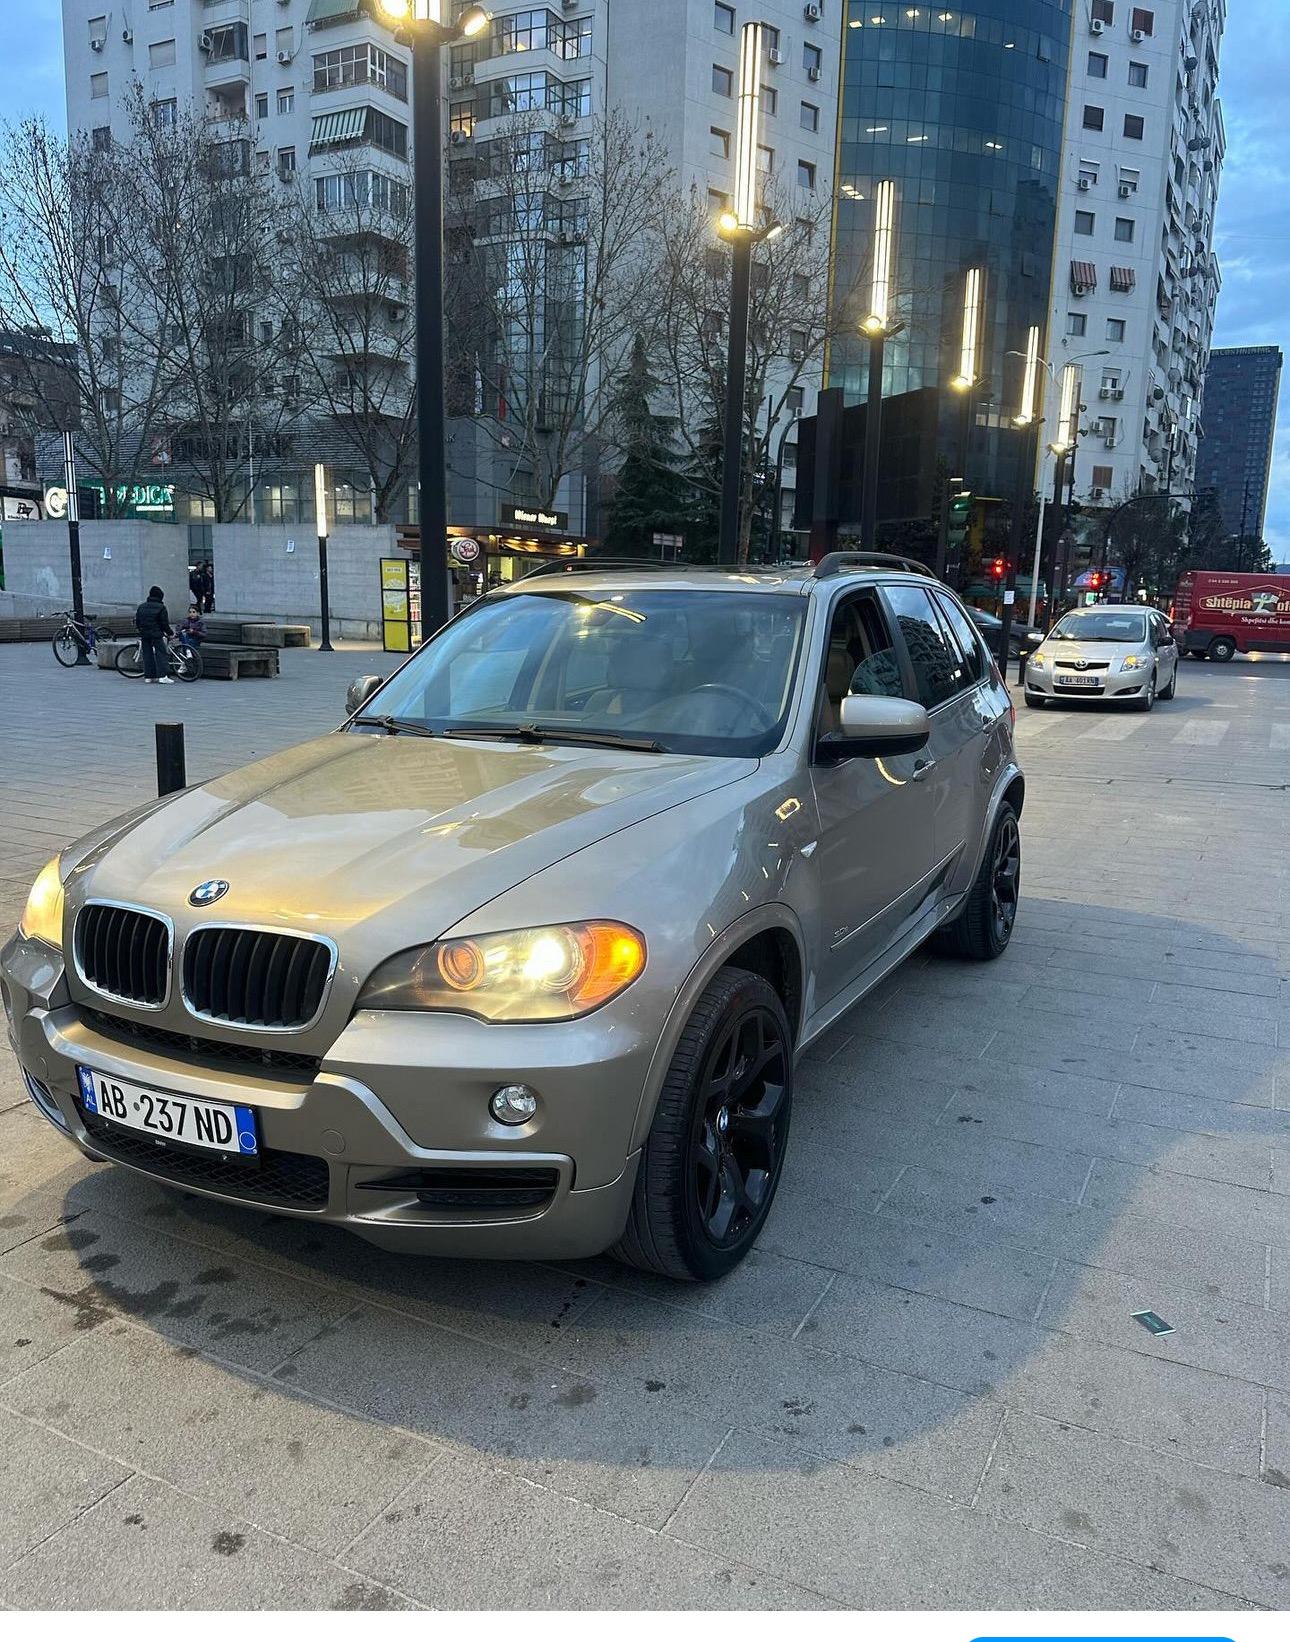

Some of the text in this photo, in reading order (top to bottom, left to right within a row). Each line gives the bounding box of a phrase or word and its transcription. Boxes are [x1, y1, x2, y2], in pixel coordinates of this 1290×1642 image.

[1206, 597, 1251, 610] shtëpia
[100, 1080, 233, 1145] AB 237 ND
